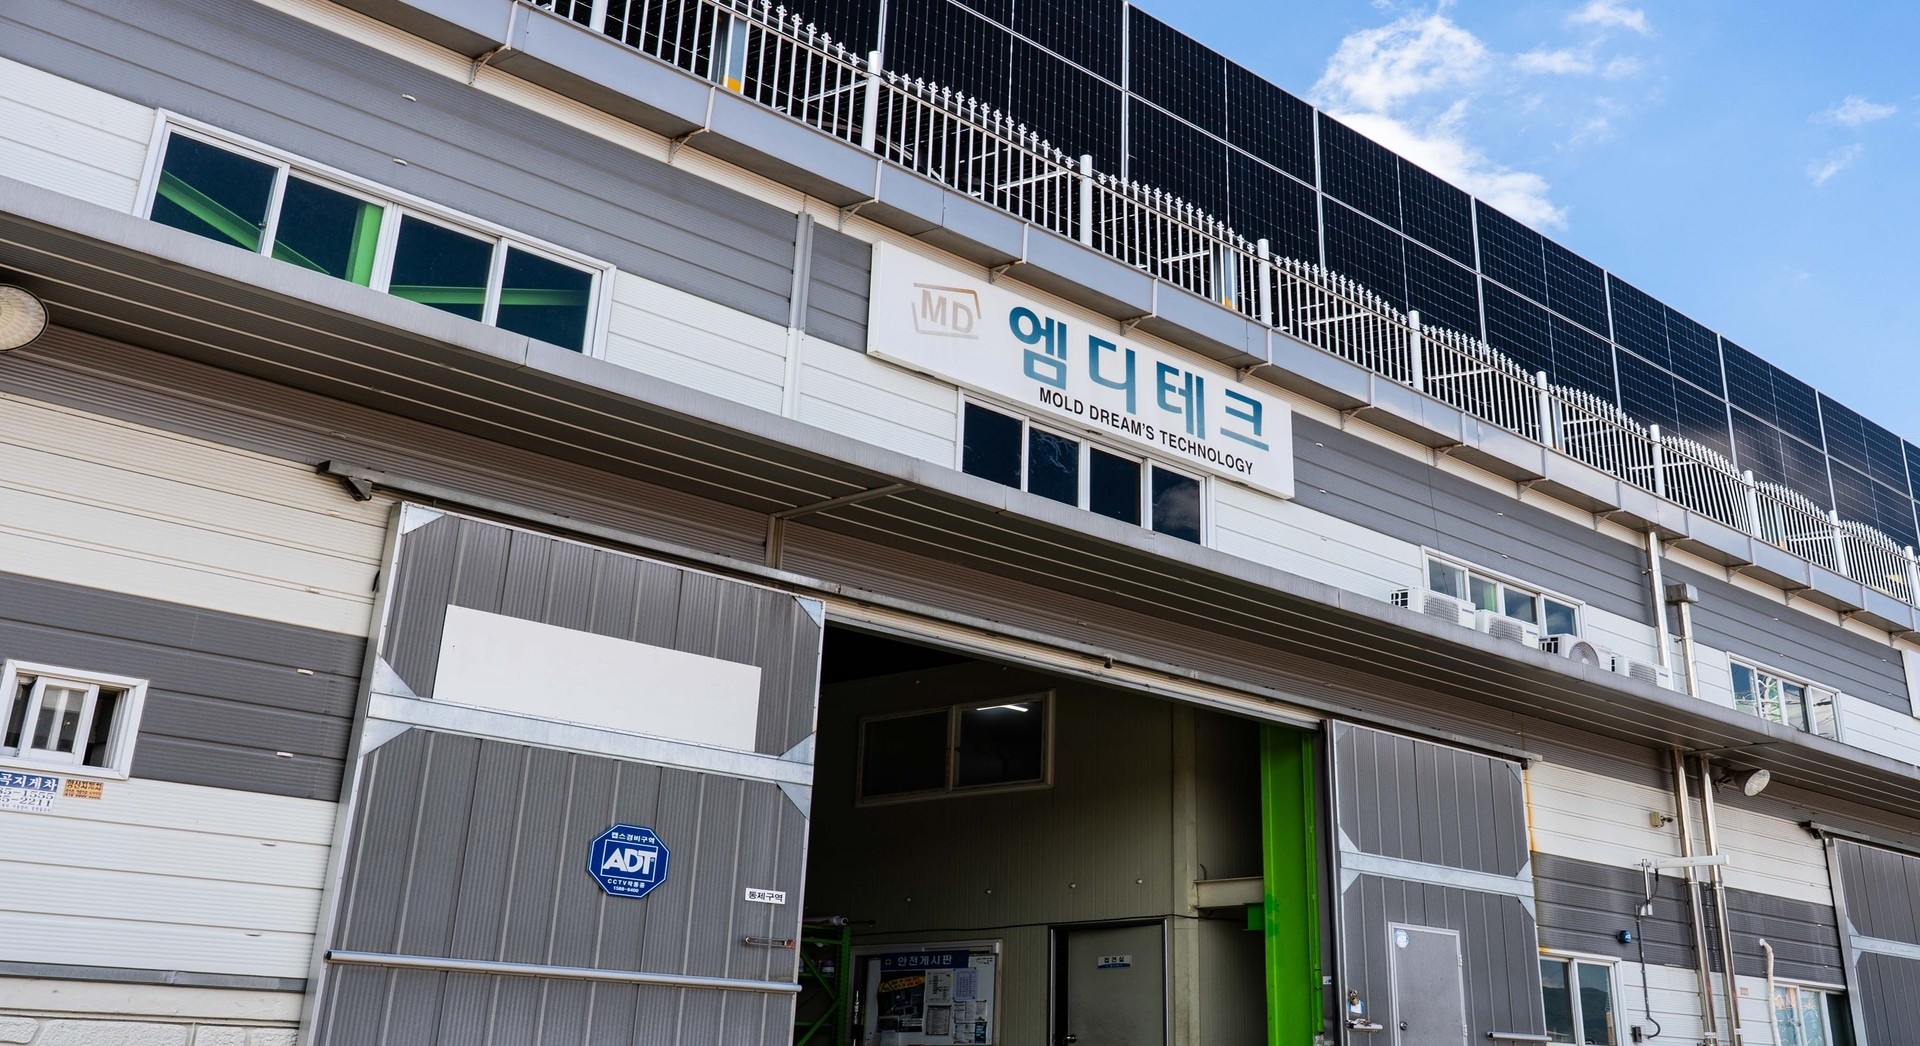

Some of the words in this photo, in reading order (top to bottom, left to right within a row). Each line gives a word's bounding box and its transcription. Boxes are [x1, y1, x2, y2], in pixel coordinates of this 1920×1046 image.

[920, 288, 975, 335] MD
[1008, 306, 1270, 452] 엠디테크
[1039, 387, 1084, 416] MOLD
[1089, 403, 1155, 441] DREAM'S
[1159, 430, 1254, 476] TECHNOLOGY
[602, 847, 657, 875] ADT
[897, 954, 953, 967] 안전게시판
